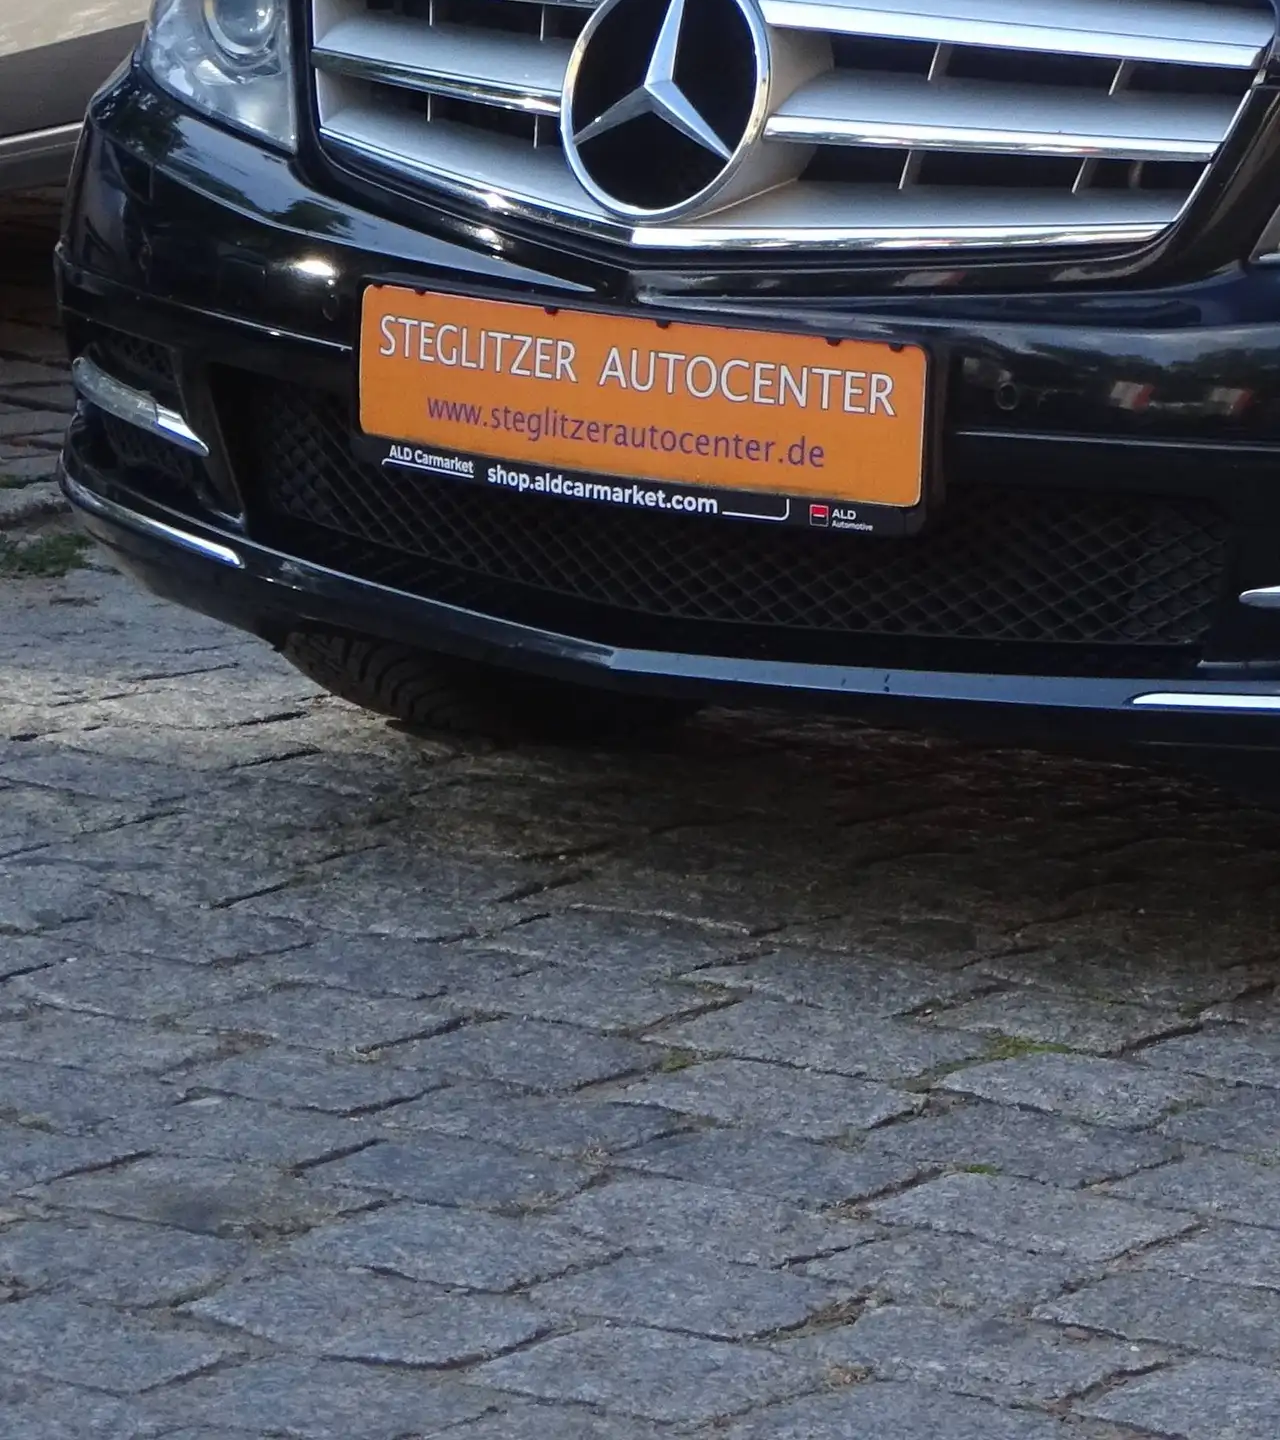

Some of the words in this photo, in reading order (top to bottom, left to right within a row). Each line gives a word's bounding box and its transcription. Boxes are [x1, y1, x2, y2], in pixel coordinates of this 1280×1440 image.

[379, 315, 579, 384] STEGLITZER
[597, 346, 898, 418] AUTOCENTER
[426, 396, 826, 469] www.steglitzerautocenter.de
[389, 445, 413, 460] ALD
[414, 450, 474, 474] Carmarket
[487, 464, 719, 515] shop.aldcarmarket.com
[832, 509, 857, 520] ALD
[832, 521, 873, 531] Automotive
